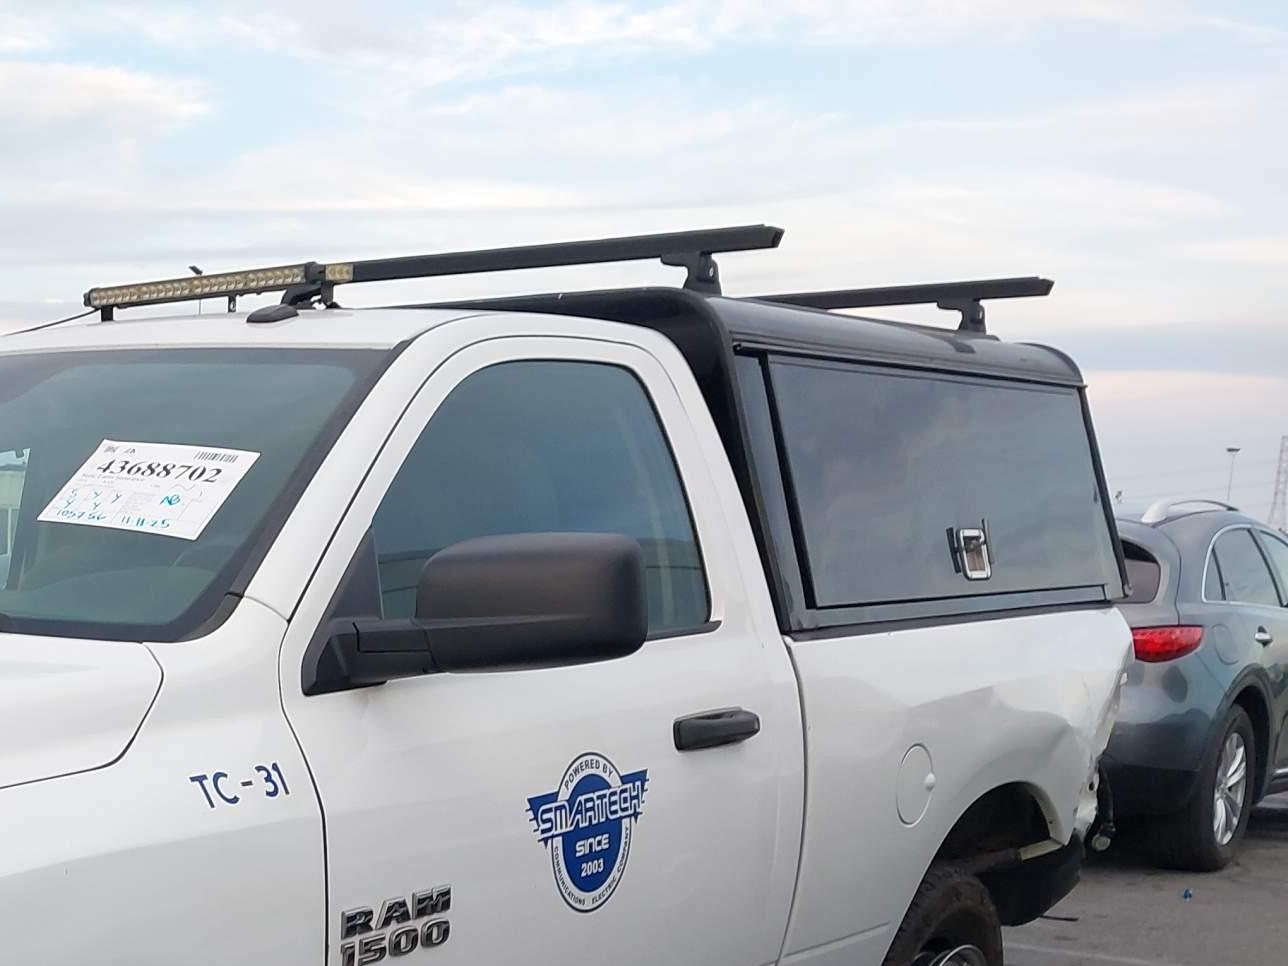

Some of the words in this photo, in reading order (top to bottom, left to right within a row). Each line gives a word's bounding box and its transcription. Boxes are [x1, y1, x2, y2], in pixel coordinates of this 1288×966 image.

[96, 459, 223, 483] 43688702
[189, 762, 290, 809] TC-31
[564, 759, 601, 790] POWERED
[602, 762, 614, 778] BY
[538, 781, 642, 837] SMARTECH
[575, 833, 610, 857] SINCE
[580, 857, 604, 878] 2003
[341, 884, 451, 940] RAM
